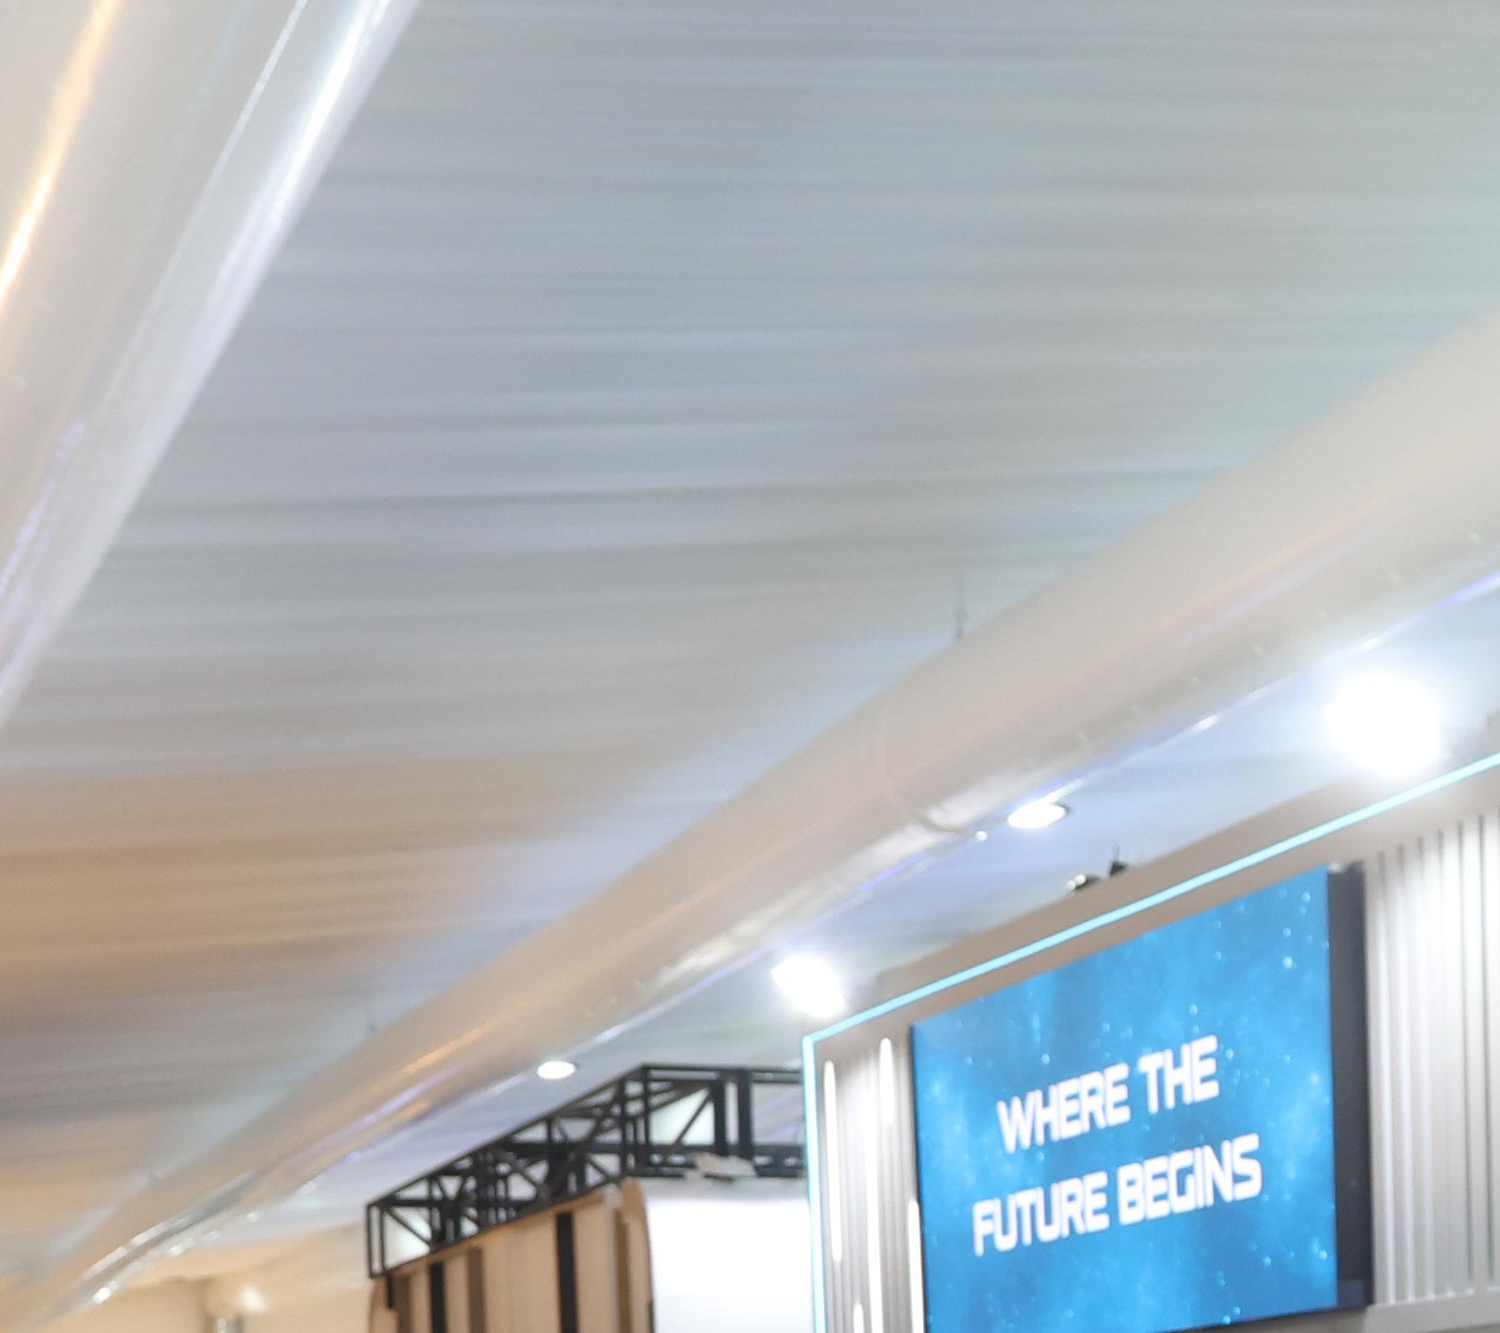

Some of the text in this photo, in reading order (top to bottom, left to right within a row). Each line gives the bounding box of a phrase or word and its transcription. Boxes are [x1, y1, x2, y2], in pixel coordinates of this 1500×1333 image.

[996, 1034, 1220, 1154] WHERE THE
[972, 1132, 1263, 1256] FUTURE BEGINS
